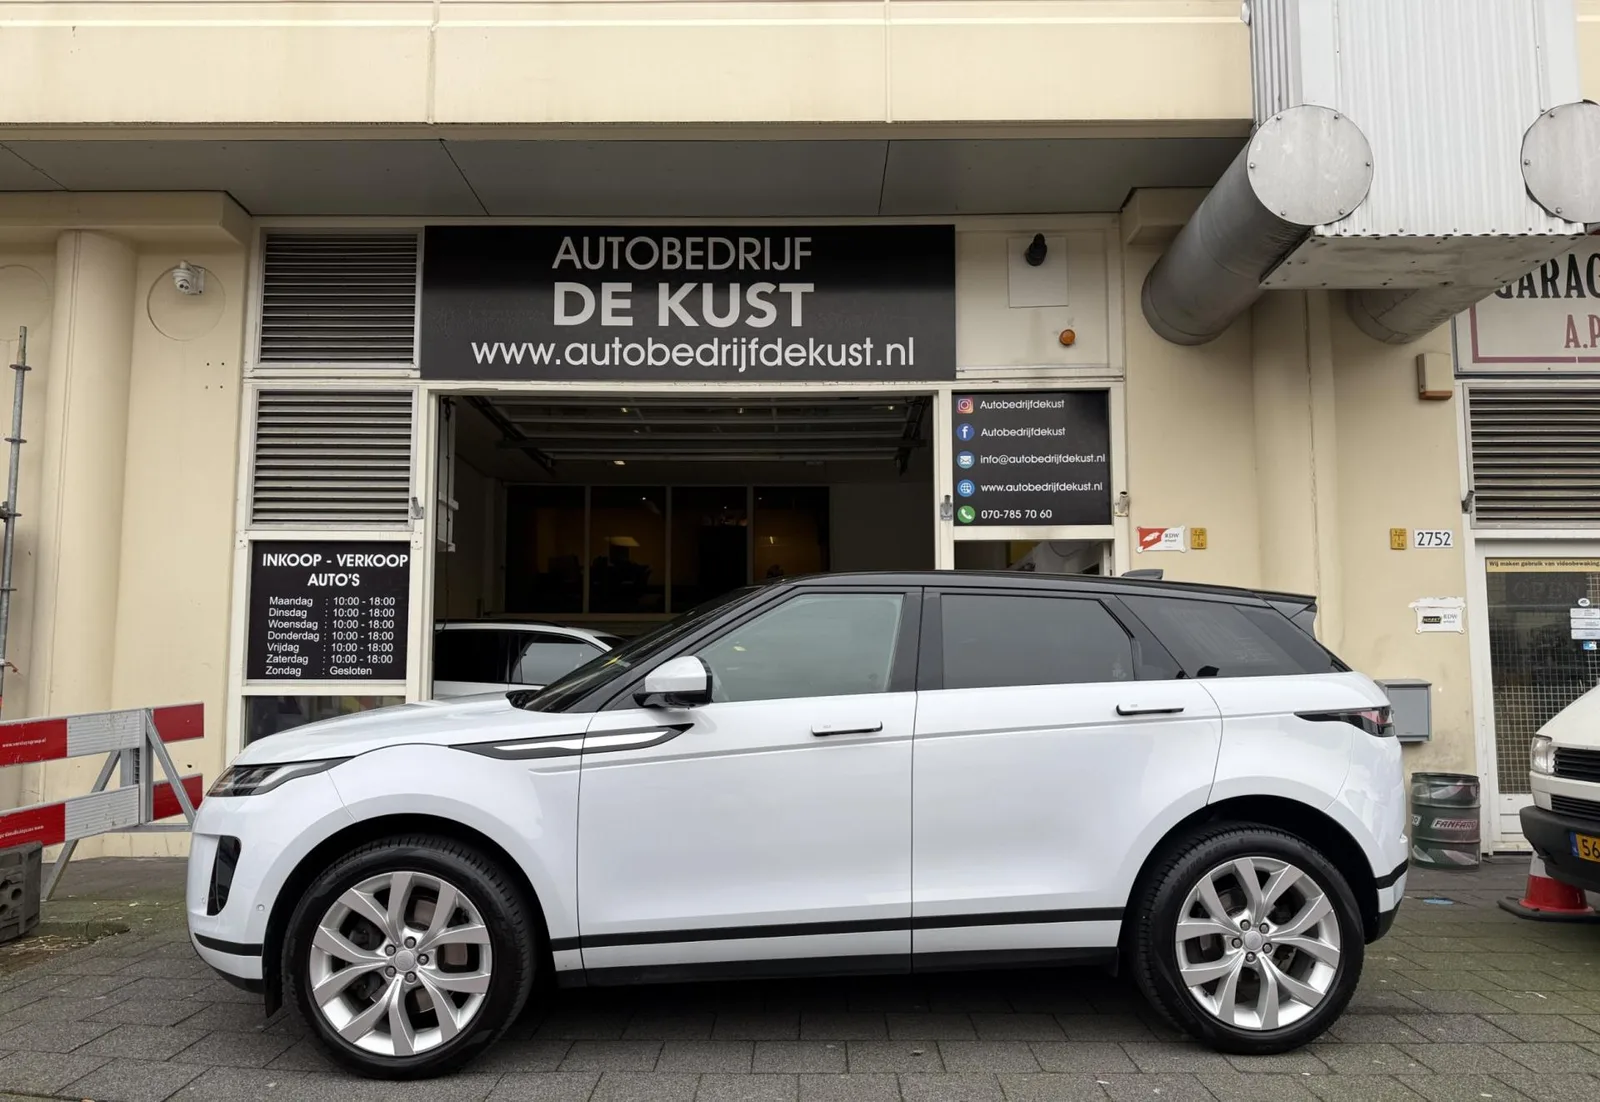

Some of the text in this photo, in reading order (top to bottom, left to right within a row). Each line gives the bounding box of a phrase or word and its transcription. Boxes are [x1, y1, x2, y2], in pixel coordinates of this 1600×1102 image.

[551, 236, 812, 271] AUTOBEDRIJF
[553, 281, 815, 328] DE KUST
[471, 337, 914, 373] www.autobedrijfdekust.nl
[980, 399, 1065, 411] Autobedrijfdekust
[980, 427, 1066, 438] Autobedrijfdekust
[980, 453, 1106, 466] info@autobedrijfdekust.nl
[980, 482, 1103, 493] www.autobedrijfdekust.nl
[981, 509, 1053, 519] 070-785 70 60
[1417, 531, 1451, 546] 2752
[262, 553, 323, 567] INKOOP
[336, 553, 409, 568] VERKOOP
[306, 573, 361, 587] AUTO'S
[269, 596, 313, 607] Maandag
[333, 597, 360, 606] 10:00
[369, 597, 396, 606] 18:00
[268, 607, 307, 619] Dinsdag
[333, 608, 359, 617] 10:00
[368, 608, 395, 617] 18:00
[267, 619, 319, 631] Woensdag
[332, 620, 359, 629] 10:00
[368, 620, 395, 629] 18:00
[267, 631, 320, 642] Donderdag
[332, 631, 358, 641] 10:00
[367, 631, 394, 641] 18:00
[267, 642, 300, 654] Vrijdag
[331, 643, 358, 652] 10:00
[367, 643, 394, 652] 18:00
[266, 654, 309, 665] Zaterdag
[330, 654, 357, 664] 10:00
[366, 654, 393, 664] 18:00
[265, 665, 302, 677] Zondag
[329, 666, 373, 676] Gesloten
[1582, 838, 1600, 859] 56
